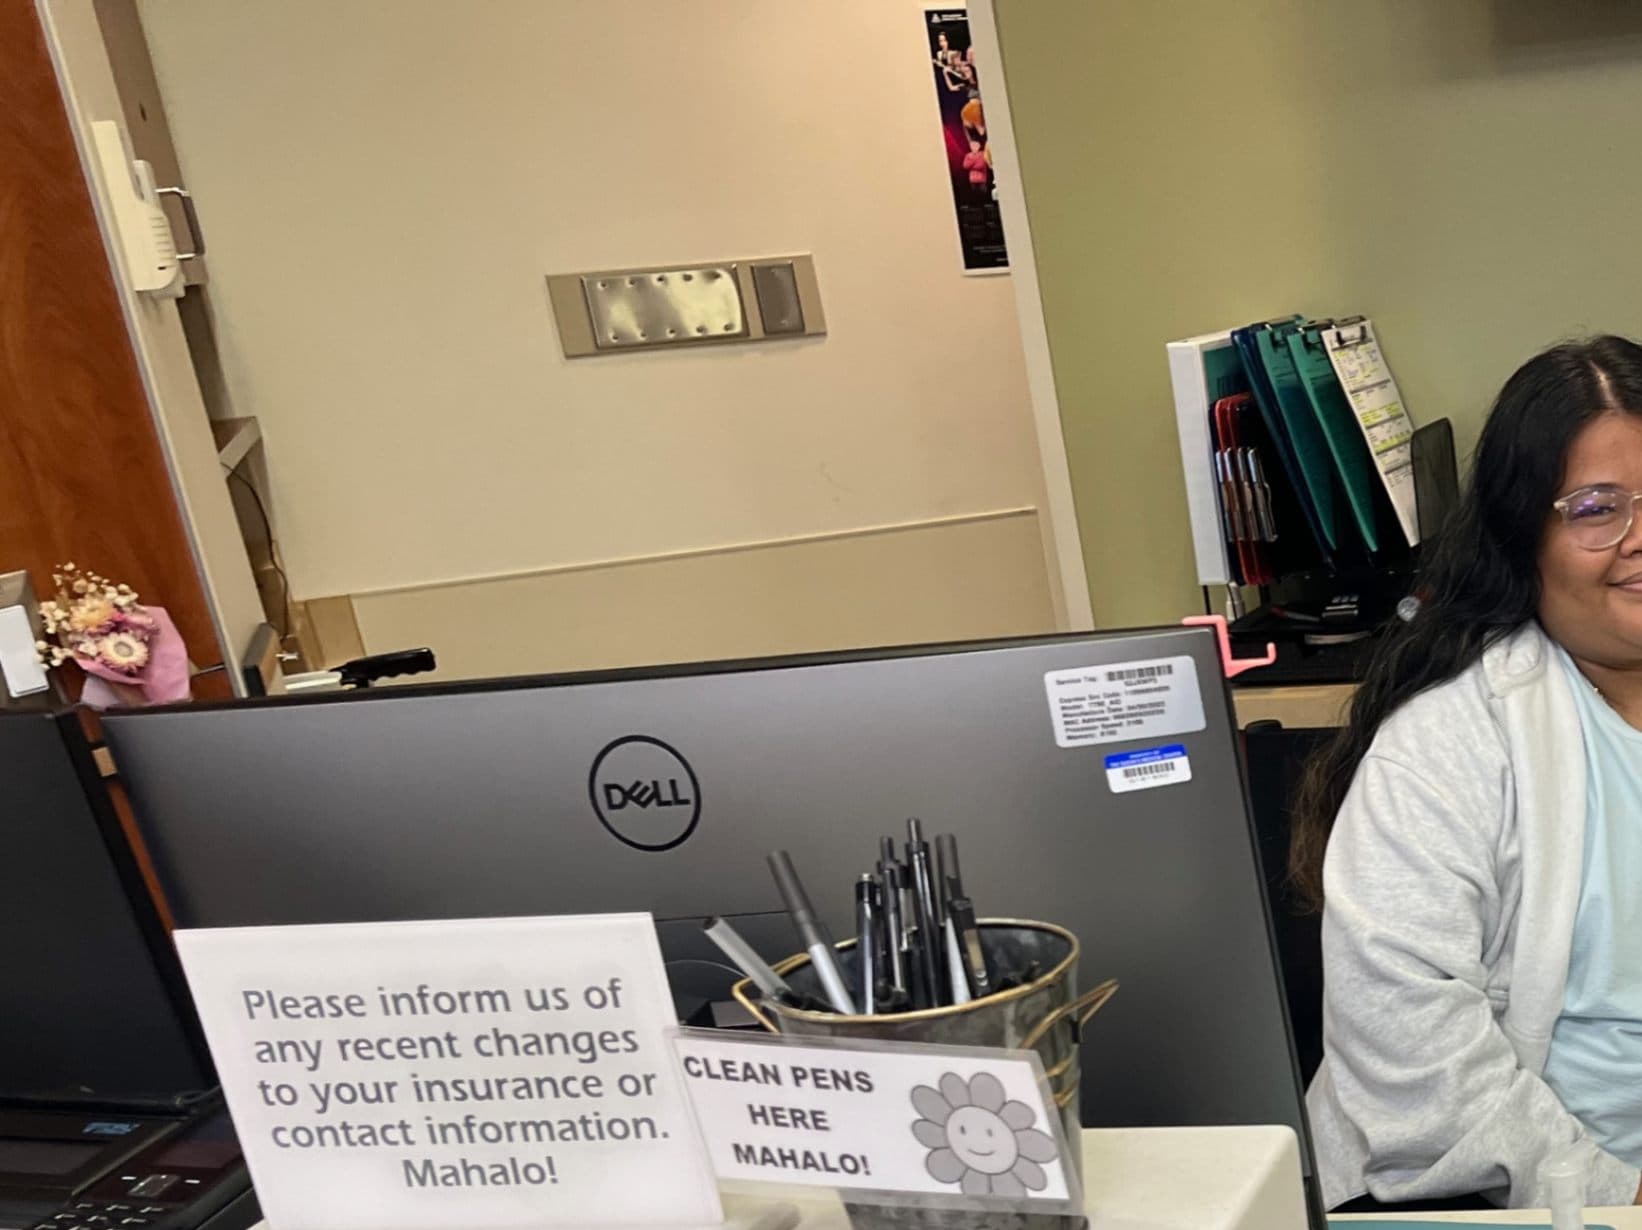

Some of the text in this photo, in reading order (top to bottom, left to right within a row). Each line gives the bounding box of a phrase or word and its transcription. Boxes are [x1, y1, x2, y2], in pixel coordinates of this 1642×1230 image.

[603, 778, 691, 810] DELL
[242, 977, 623, 1020] Please inform us of
[254, 1028, 640, 1071] any recent changes
[257, 1071, 657, 1114] to your insurance or
[683, 1055, 874, 1093] CLEAN PENS
[271, 1111, 670, 1149] contact information.
[748, 1104, 831, 1132] HERE
[402, 1156, 558, 1188] Mahalo!
[732, 1143, 871, 1177] MAHALO!
